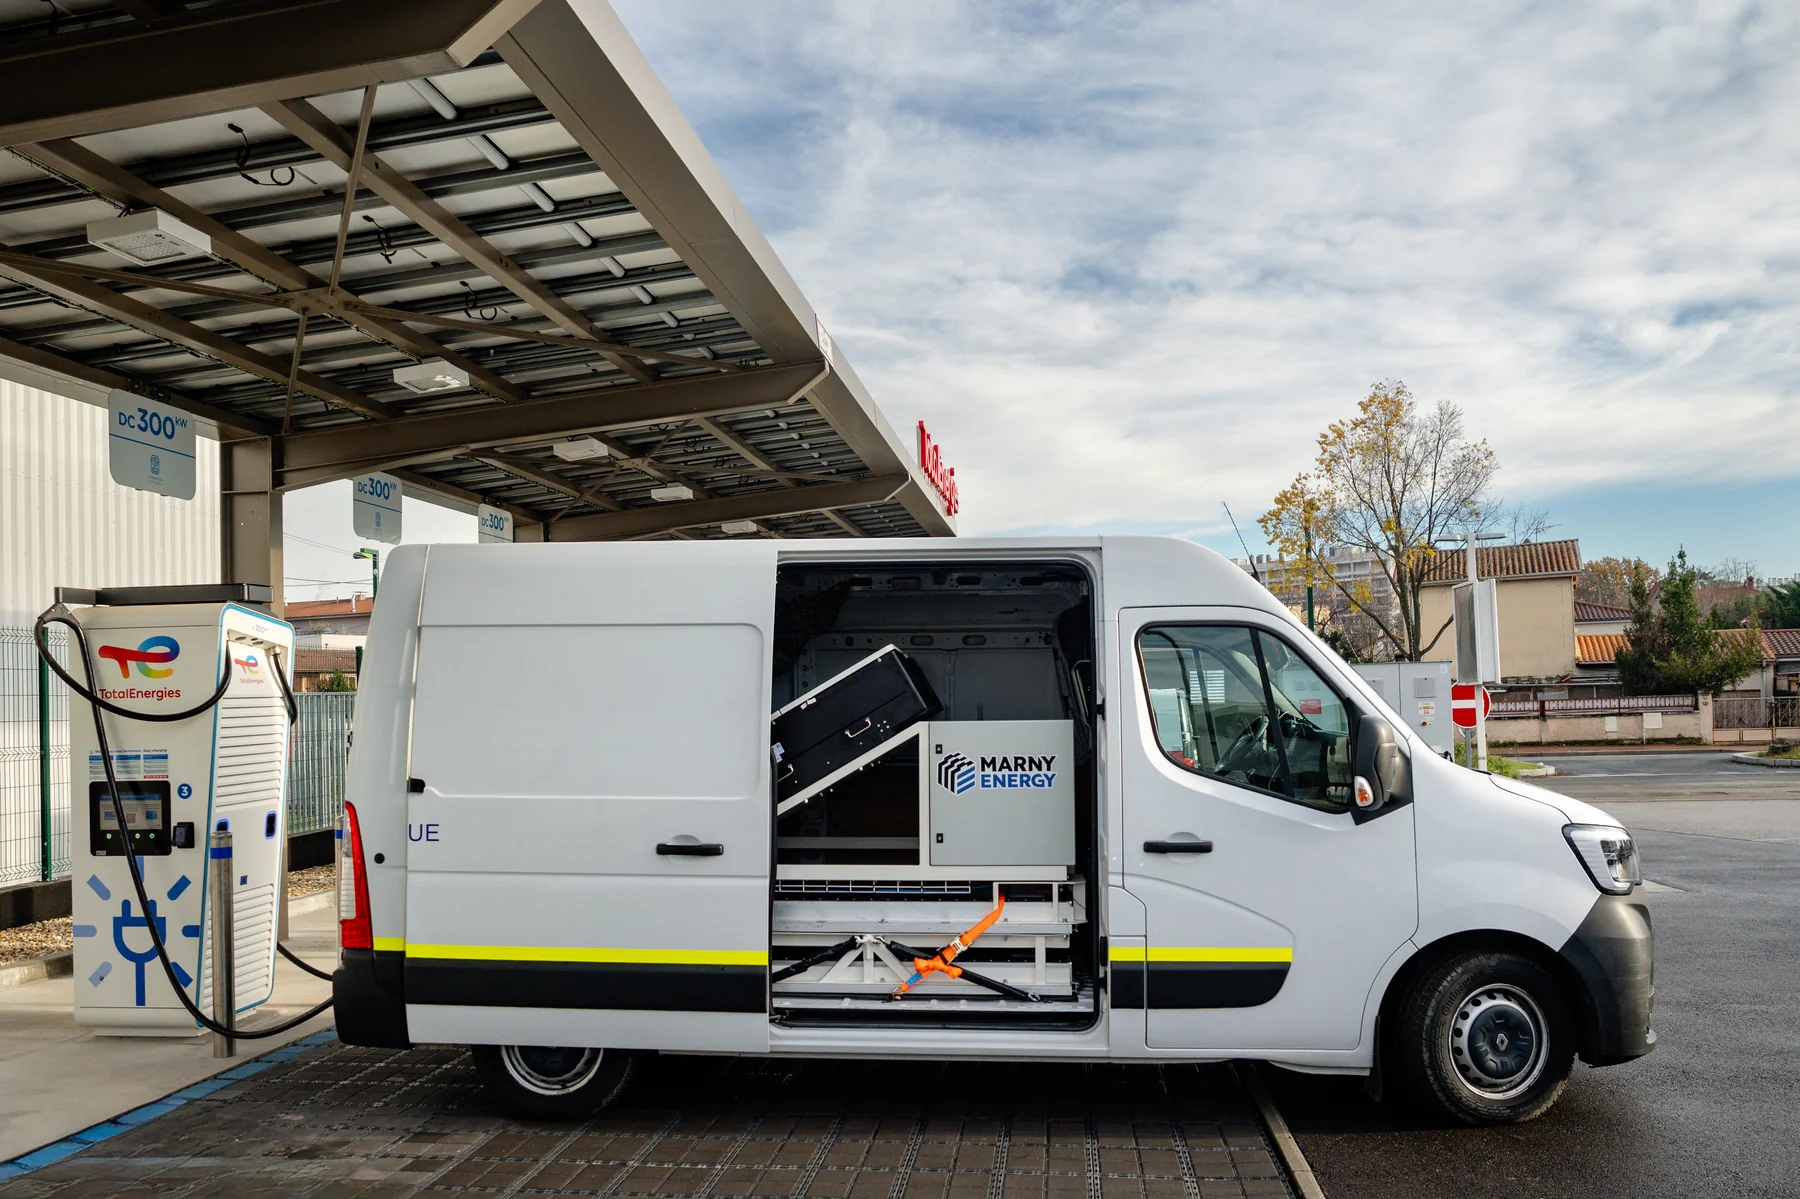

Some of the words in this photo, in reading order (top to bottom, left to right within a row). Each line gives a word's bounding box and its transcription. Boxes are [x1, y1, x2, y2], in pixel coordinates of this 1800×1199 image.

[118, 411, 136, 429] DC
[137, 407, 175, 440] 300
[175, 416, 188, 428] kW
[357, 481, 368, 494] DC
[368, 477, 390, 500] 300
[390, 481, 398, 491] kW
[481, 517, 489, 527] DC
[488, 513, 504, 531] 300
[99, 688, 181, 701] TotalEnergies
[980, 755, 1056, 772] MARNY
[980, 773, 1056, 788] ENERGY
[181, 786, 188, 797] 3
[408, 823, 440, 842] UE
